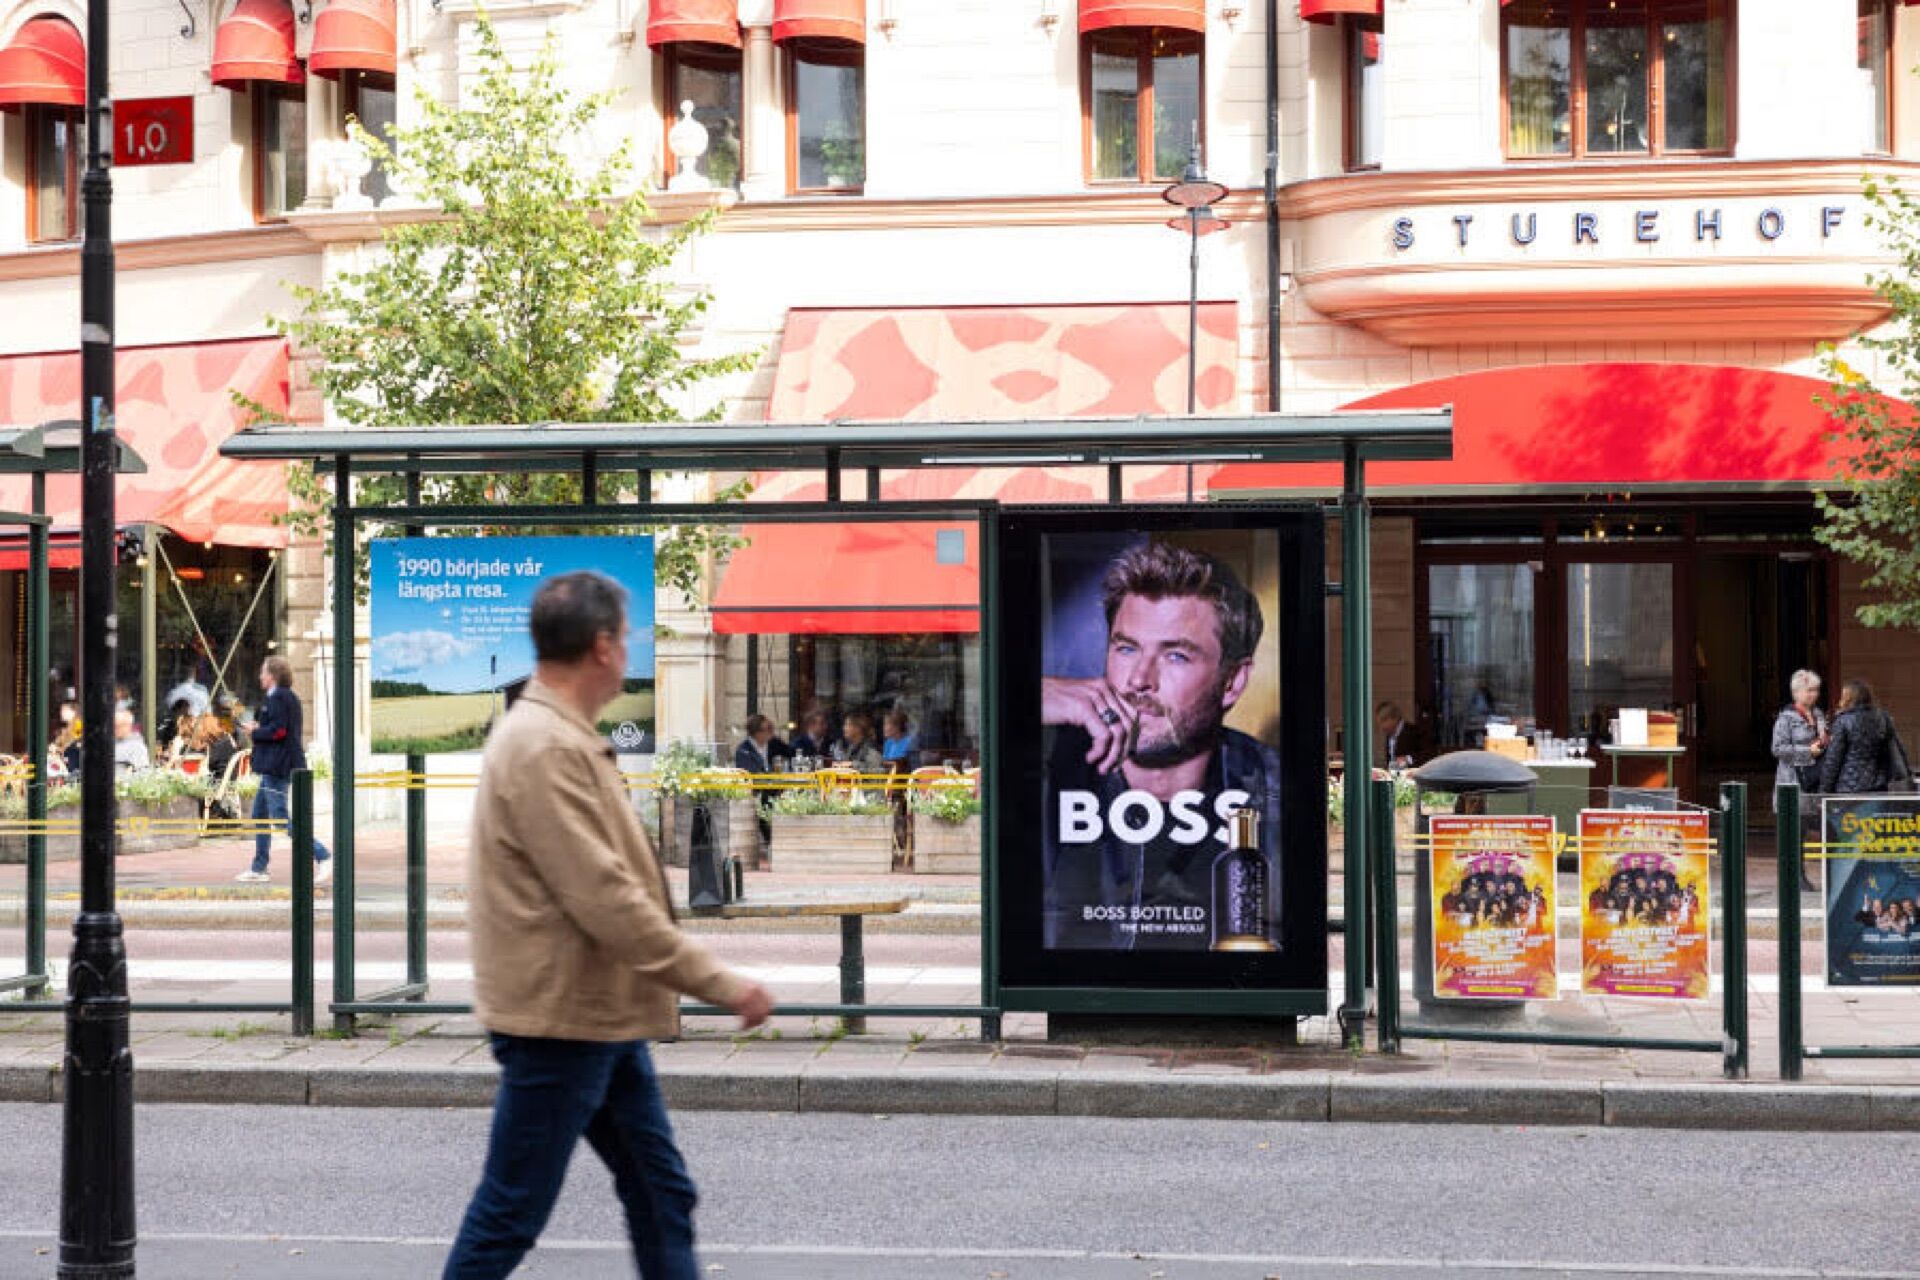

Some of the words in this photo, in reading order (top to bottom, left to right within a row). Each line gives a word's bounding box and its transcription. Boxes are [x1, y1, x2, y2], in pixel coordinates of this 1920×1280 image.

[125, 121, 167, 159] 1,0
[1393, 206, 1846, 249] STUREHOF
[399, 558, 442, 577] 1990
[445, 558, 510, 580] började
[513, 556, 543, 577] vår
[398, 579, 461, 601] längsta
[466, 582, 508, 598] resa.
[1059, 788, 1252, 844] BOSS
[1082, 905, 1126, 921] BOSS
[1130, 905, 1206, 921] BOTTLED
